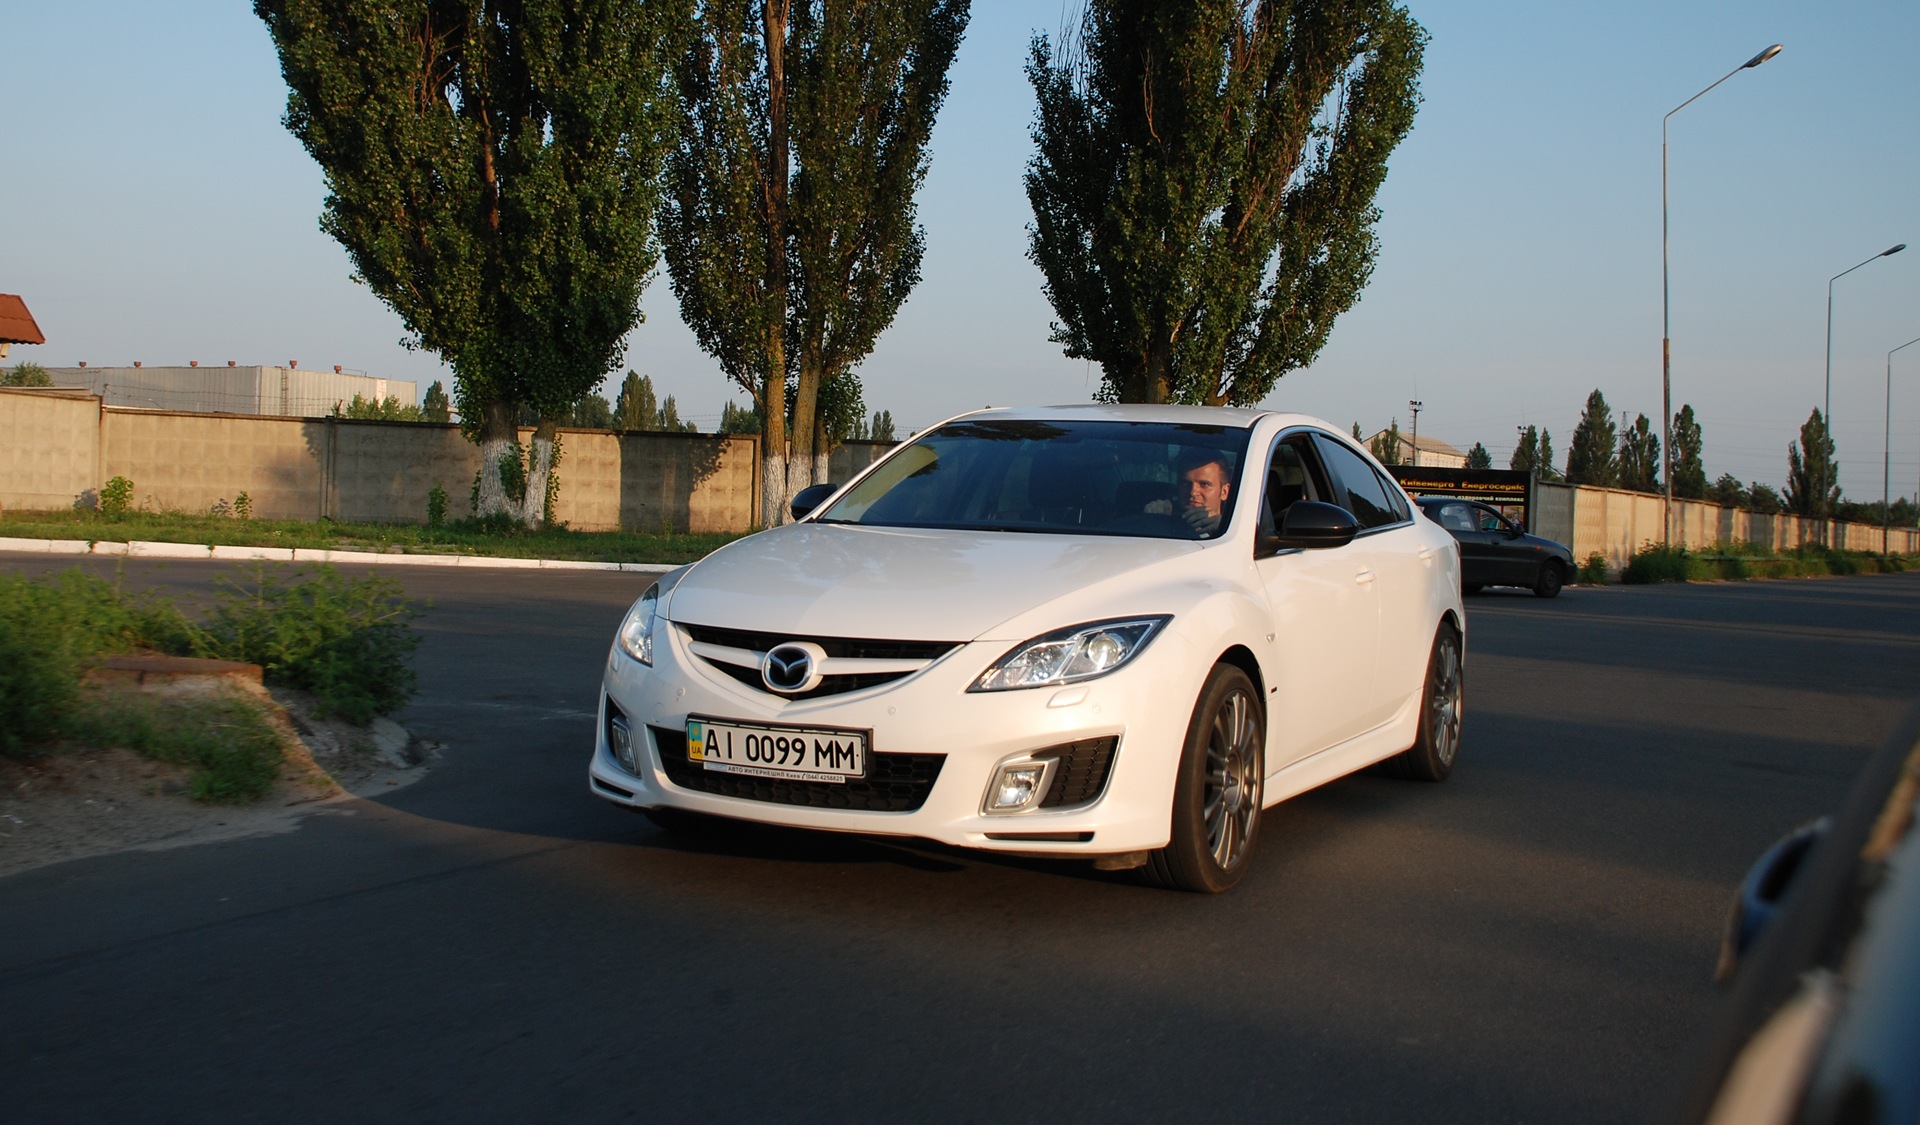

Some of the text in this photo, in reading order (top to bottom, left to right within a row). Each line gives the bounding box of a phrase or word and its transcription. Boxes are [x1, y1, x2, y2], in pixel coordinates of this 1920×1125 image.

[1400, 478, 1525, 491] Київенерго Енергосервіс
[691, 745, 702, 755] UA
[745, 734, 806, 766] 0099
[814, 738, 855, 770] MM
